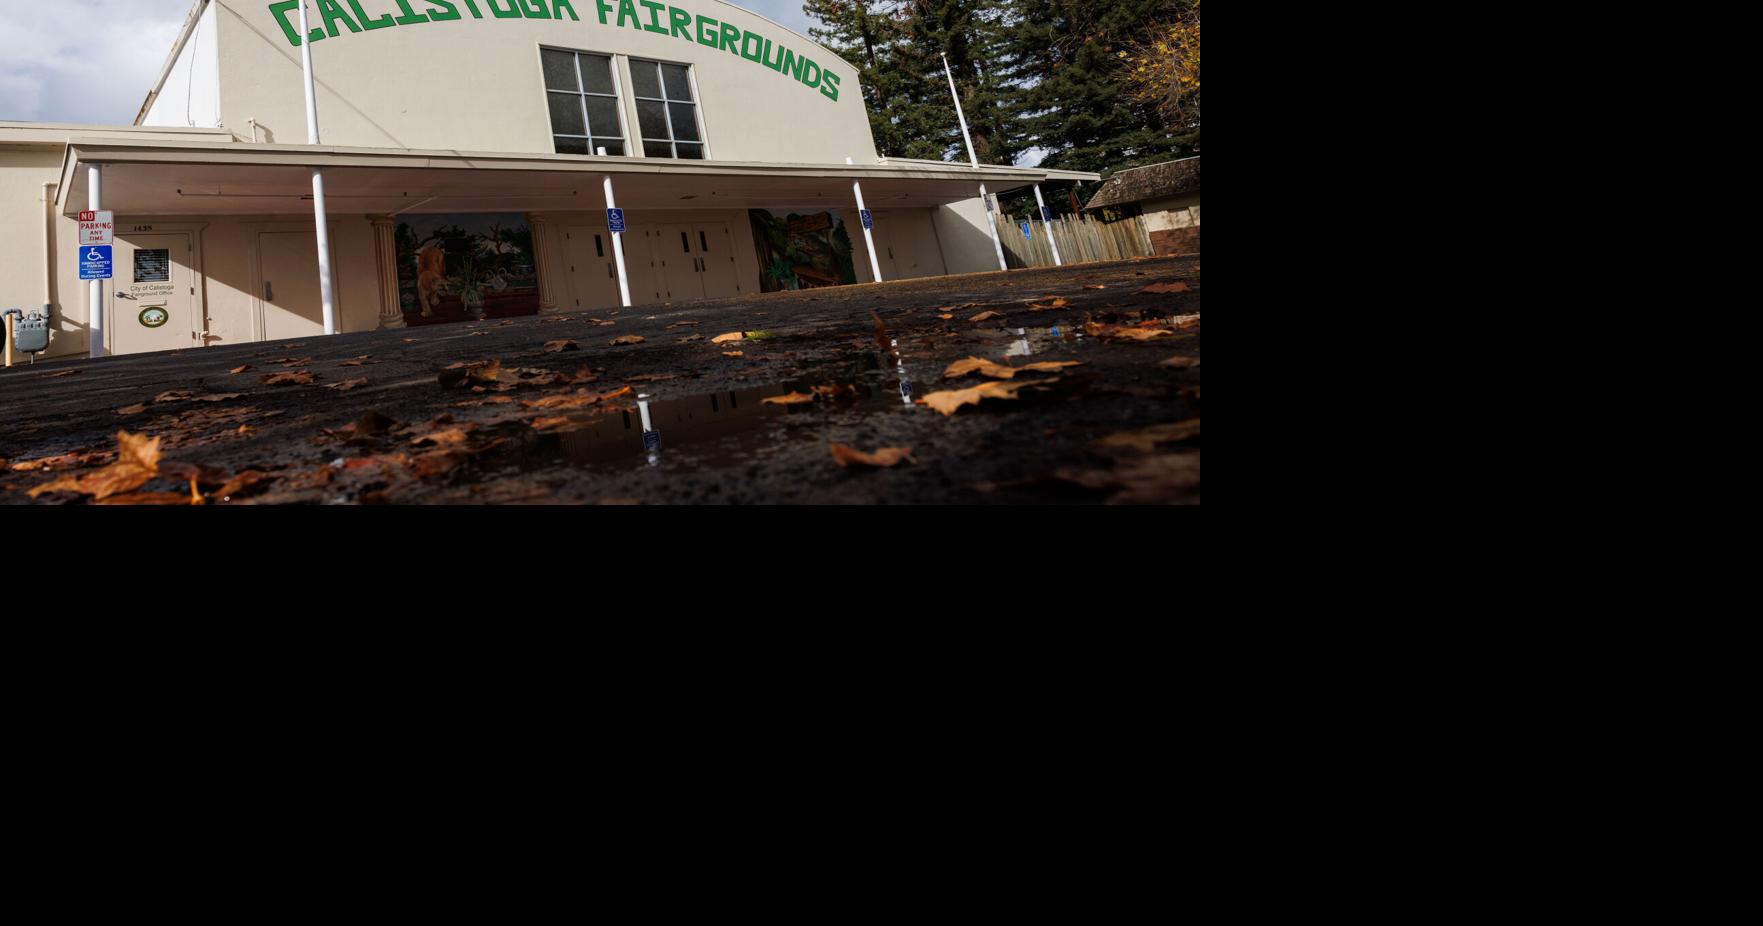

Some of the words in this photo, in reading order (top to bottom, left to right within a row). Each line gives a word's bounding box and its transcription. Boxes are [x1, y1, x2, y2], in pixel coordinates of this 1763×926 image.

[597, 0, 841, 102] FAIRGROUNDS
[81, 212, 94, 220] NO
[80, 222, 112, 230] PARKING
